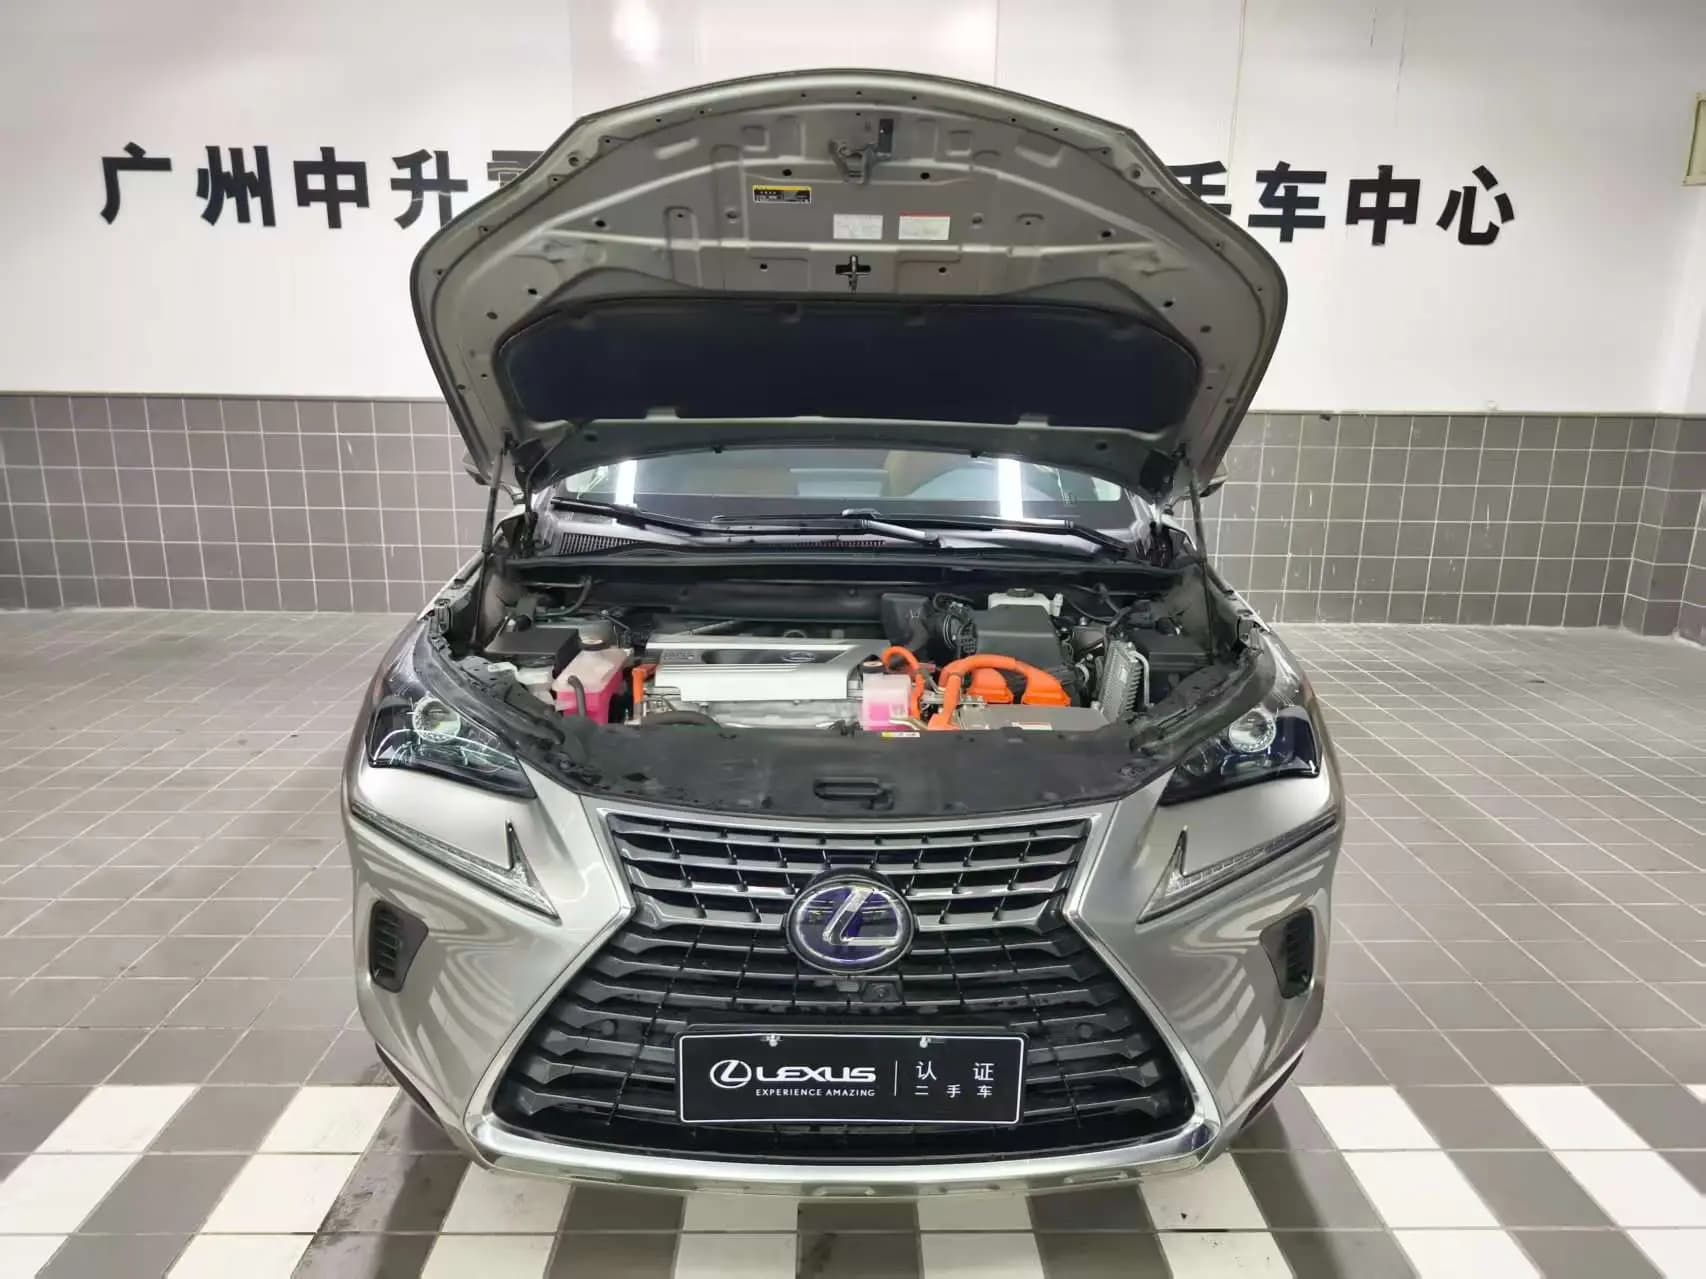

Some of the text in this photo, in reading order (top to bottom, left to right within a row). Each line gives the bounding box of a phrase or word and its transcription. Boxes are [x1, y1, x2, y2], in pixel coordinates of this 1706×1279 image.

[756, 1066, 877, 1083] LEXUS
[915, 1060, 995, 1082] 认证
[755, 1088, 876, 1097] EXPERIENCE AMAZING
[914, 1084, 993, 1099] 二手车
